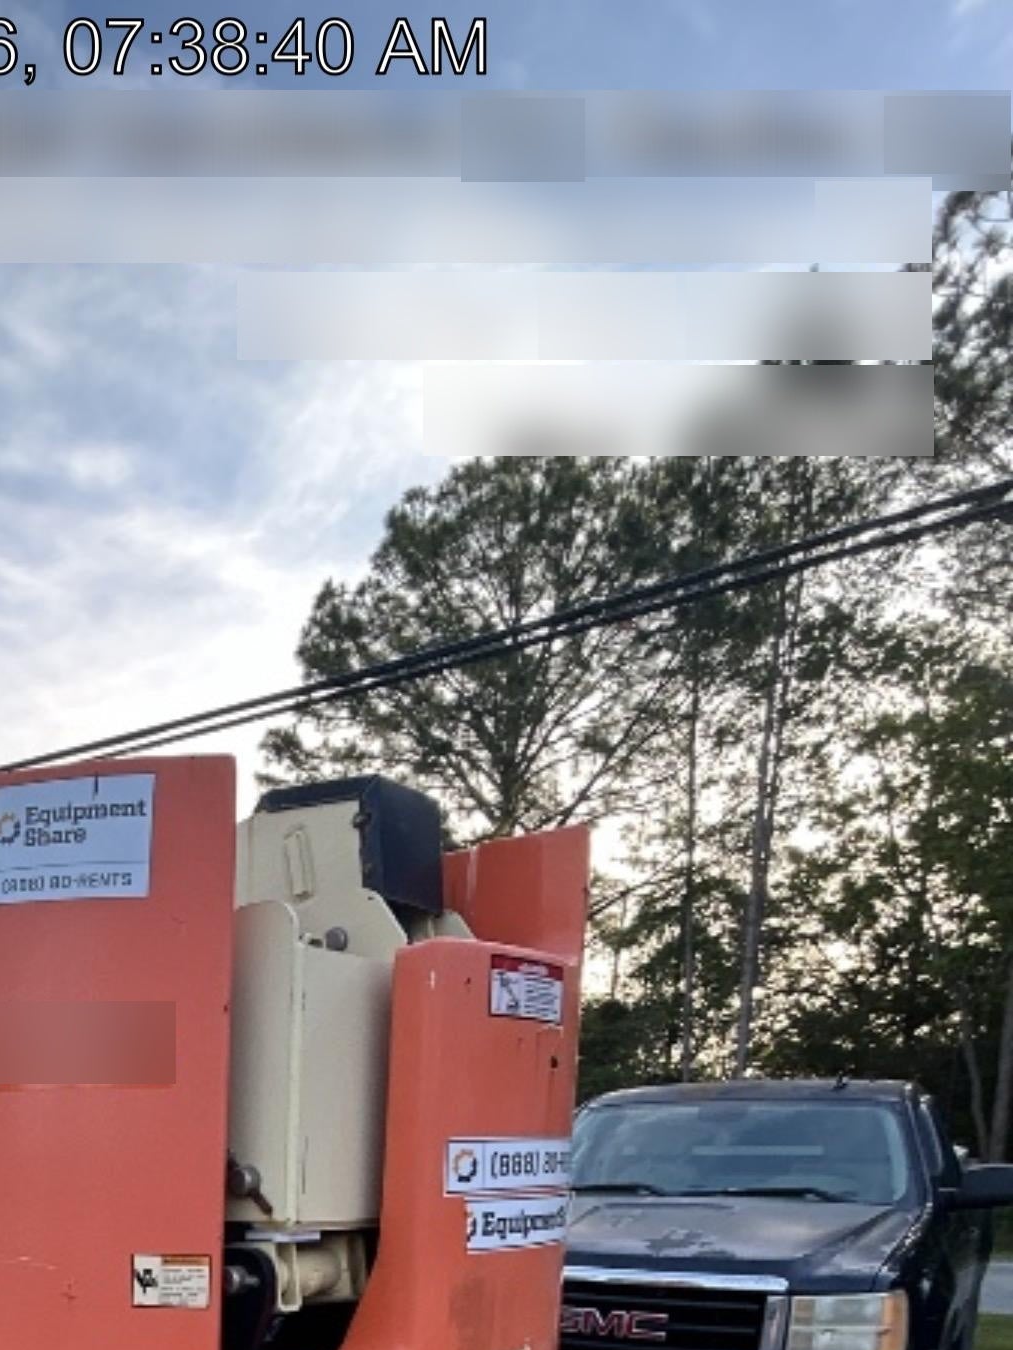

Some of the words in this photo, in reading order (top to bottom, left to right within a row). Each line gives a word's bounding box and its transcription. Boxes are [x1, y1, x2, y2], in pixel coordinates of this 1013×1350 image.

[25, 799, 146, 828] Equipment
[24, 828, 86, 847] Share
[491, 1151, 539, 1179] (888)
